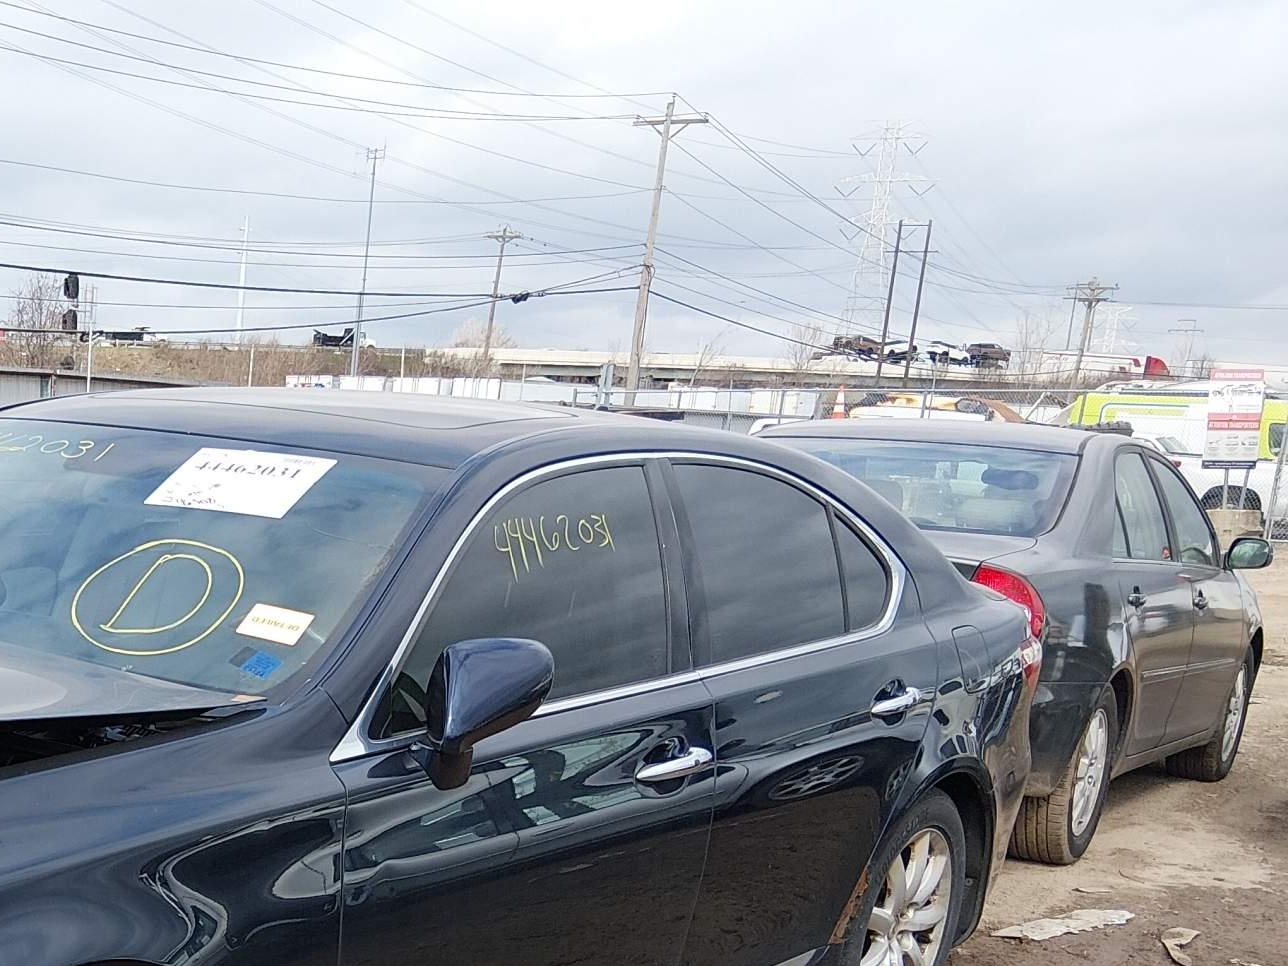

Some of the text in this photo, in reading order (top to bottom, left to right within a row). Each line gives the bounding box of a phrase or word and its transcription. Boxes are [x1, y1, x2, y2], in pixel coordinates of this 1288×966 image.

[194, 460, 302, 479] 44462031
[494, 514, 615, 583] 44462031
[100, 554, 212, 634] D
